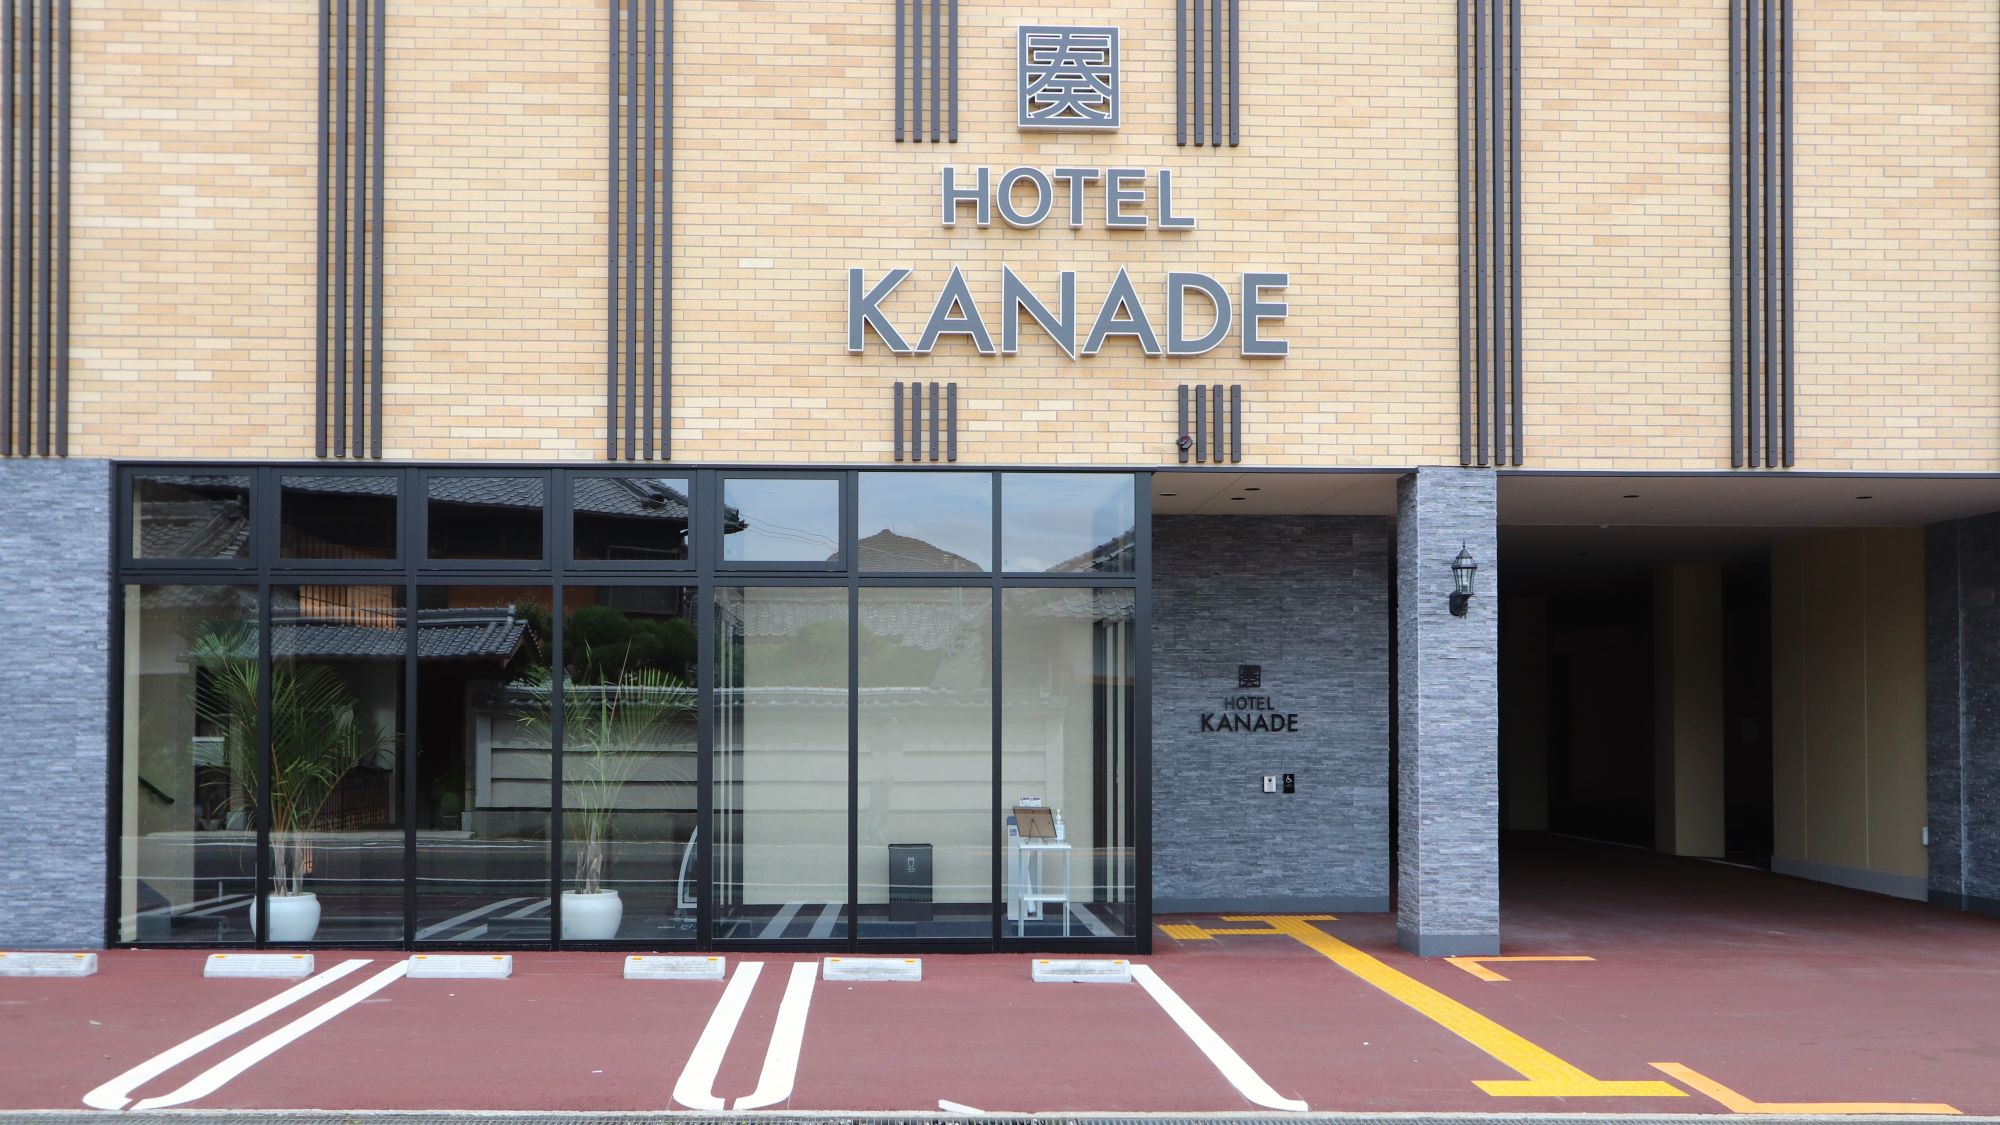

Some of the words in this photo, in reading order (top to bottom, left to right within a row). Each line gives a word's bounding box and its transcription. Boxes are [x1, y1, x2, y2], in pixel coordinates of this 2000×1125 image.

[942, 166, 1196, 230] HOTEL
[848, 264, 1290, 360] KANADE
[1201, 713, 1298, 732] KANADE
[1224, 697, 1275, 710] HOTEL
